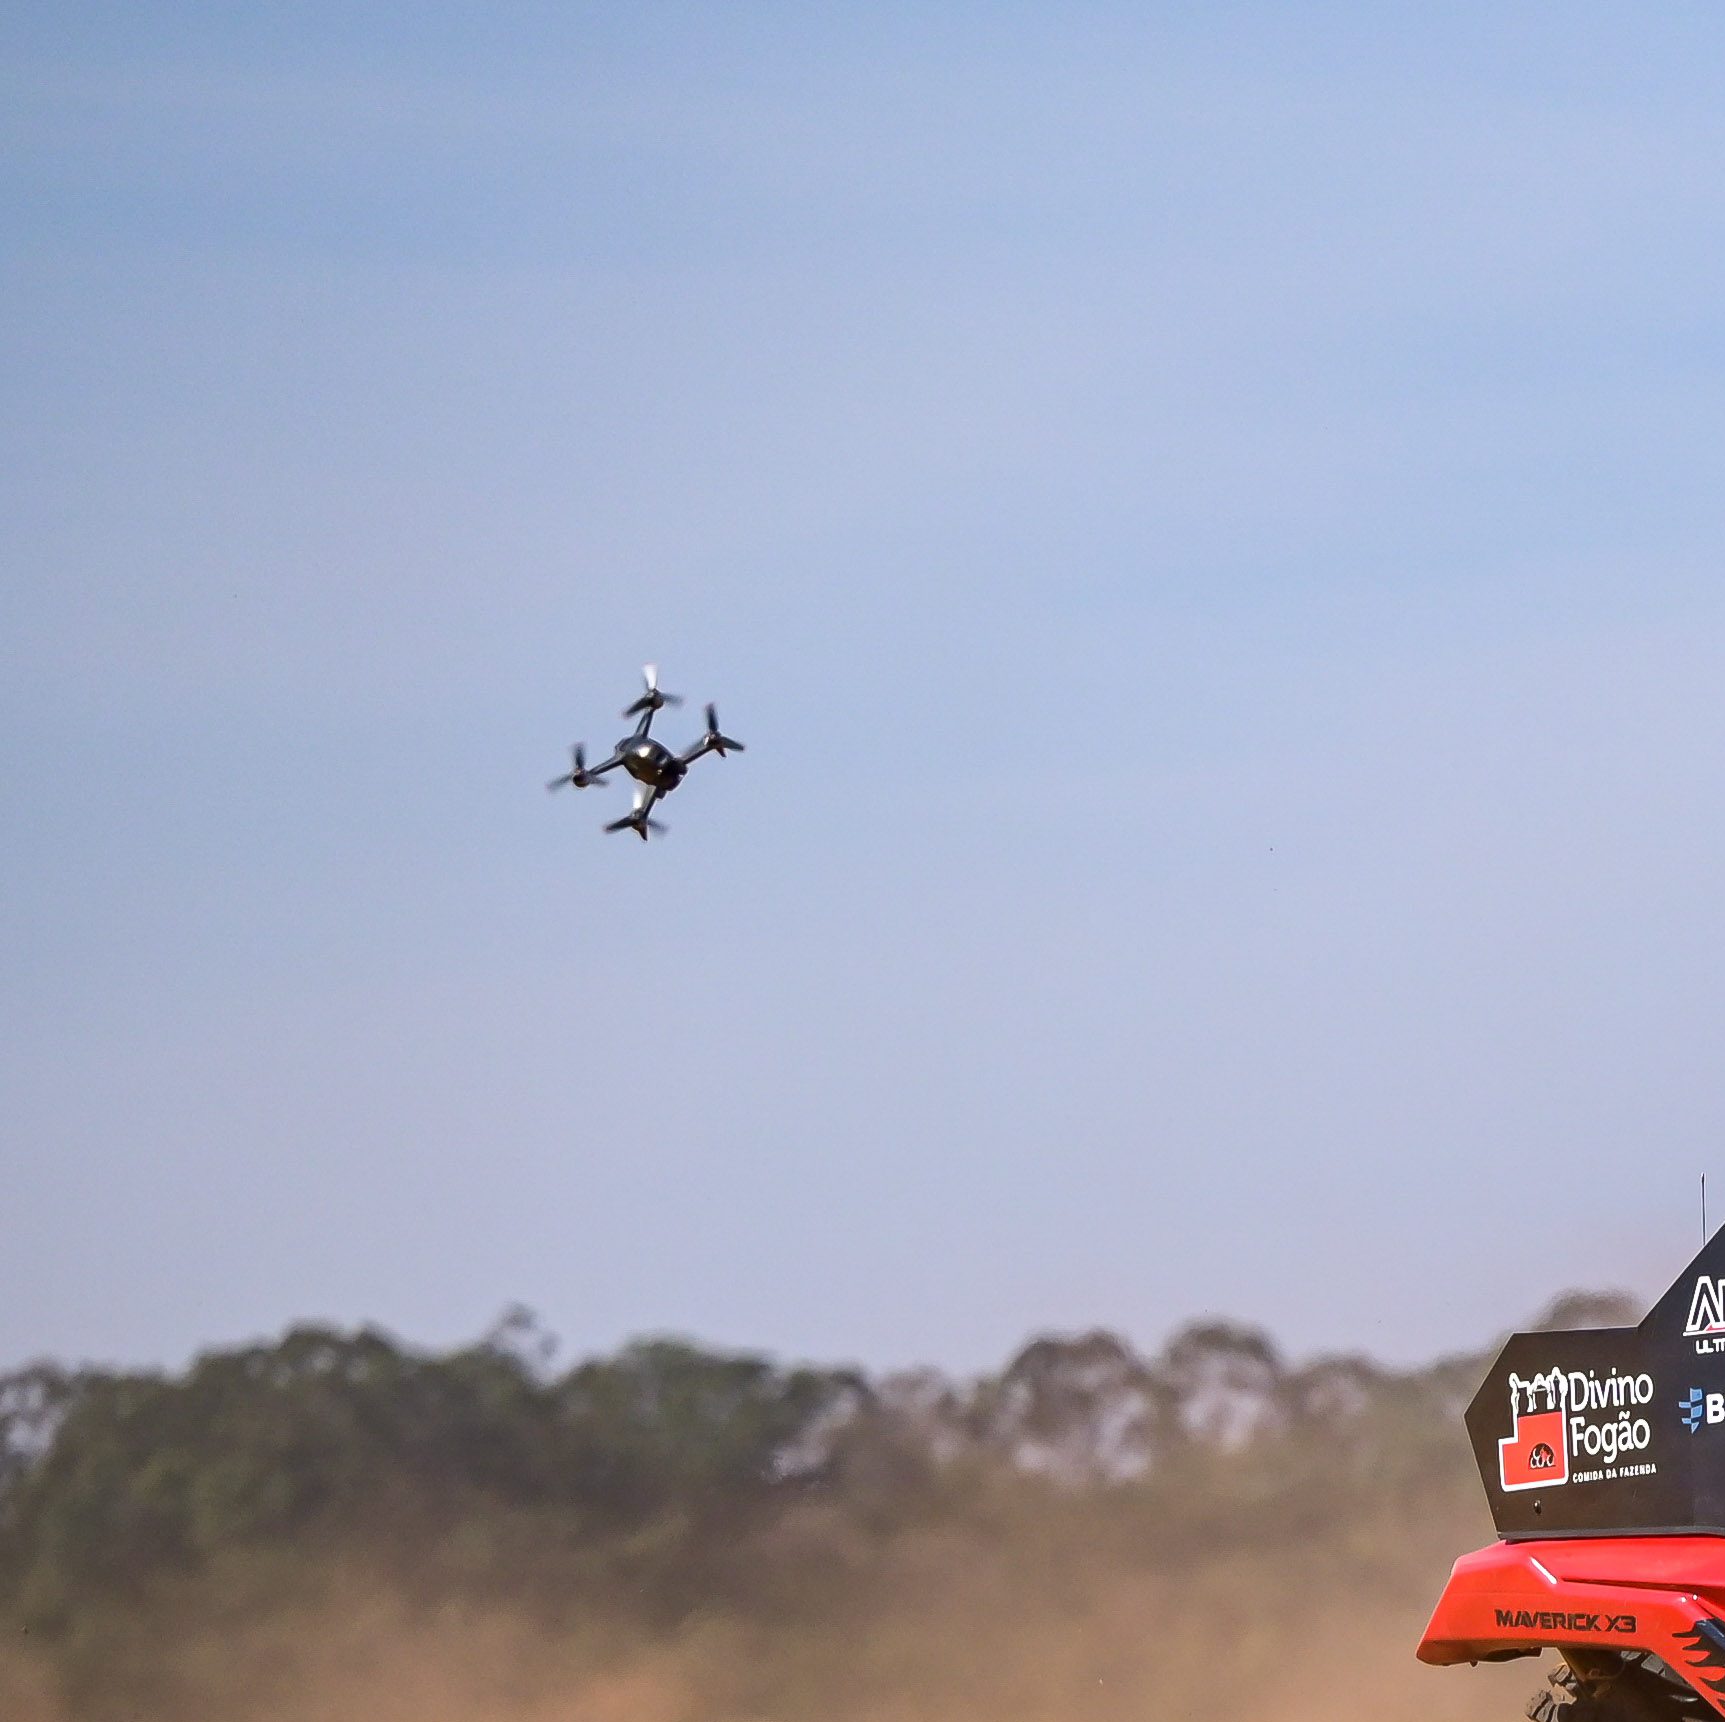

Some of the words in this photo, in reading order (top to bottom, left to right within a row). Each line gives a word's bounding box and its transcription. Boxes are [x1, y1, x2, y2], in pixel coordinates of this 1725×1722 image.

[1568, 1367, 1654, 1412] Divino
[1569, 1410, 1651, 1464] Fogão
[1572, 1470, 1604, 1484] COMIDA
[1605, 1468, 1618, 1480] DA
[1619, 1463, 1657, 1478] FAZENDA
[1494, 1609, 1601, 1631] MAVERICK
[1602, 1613, 1637, 1633] X3
